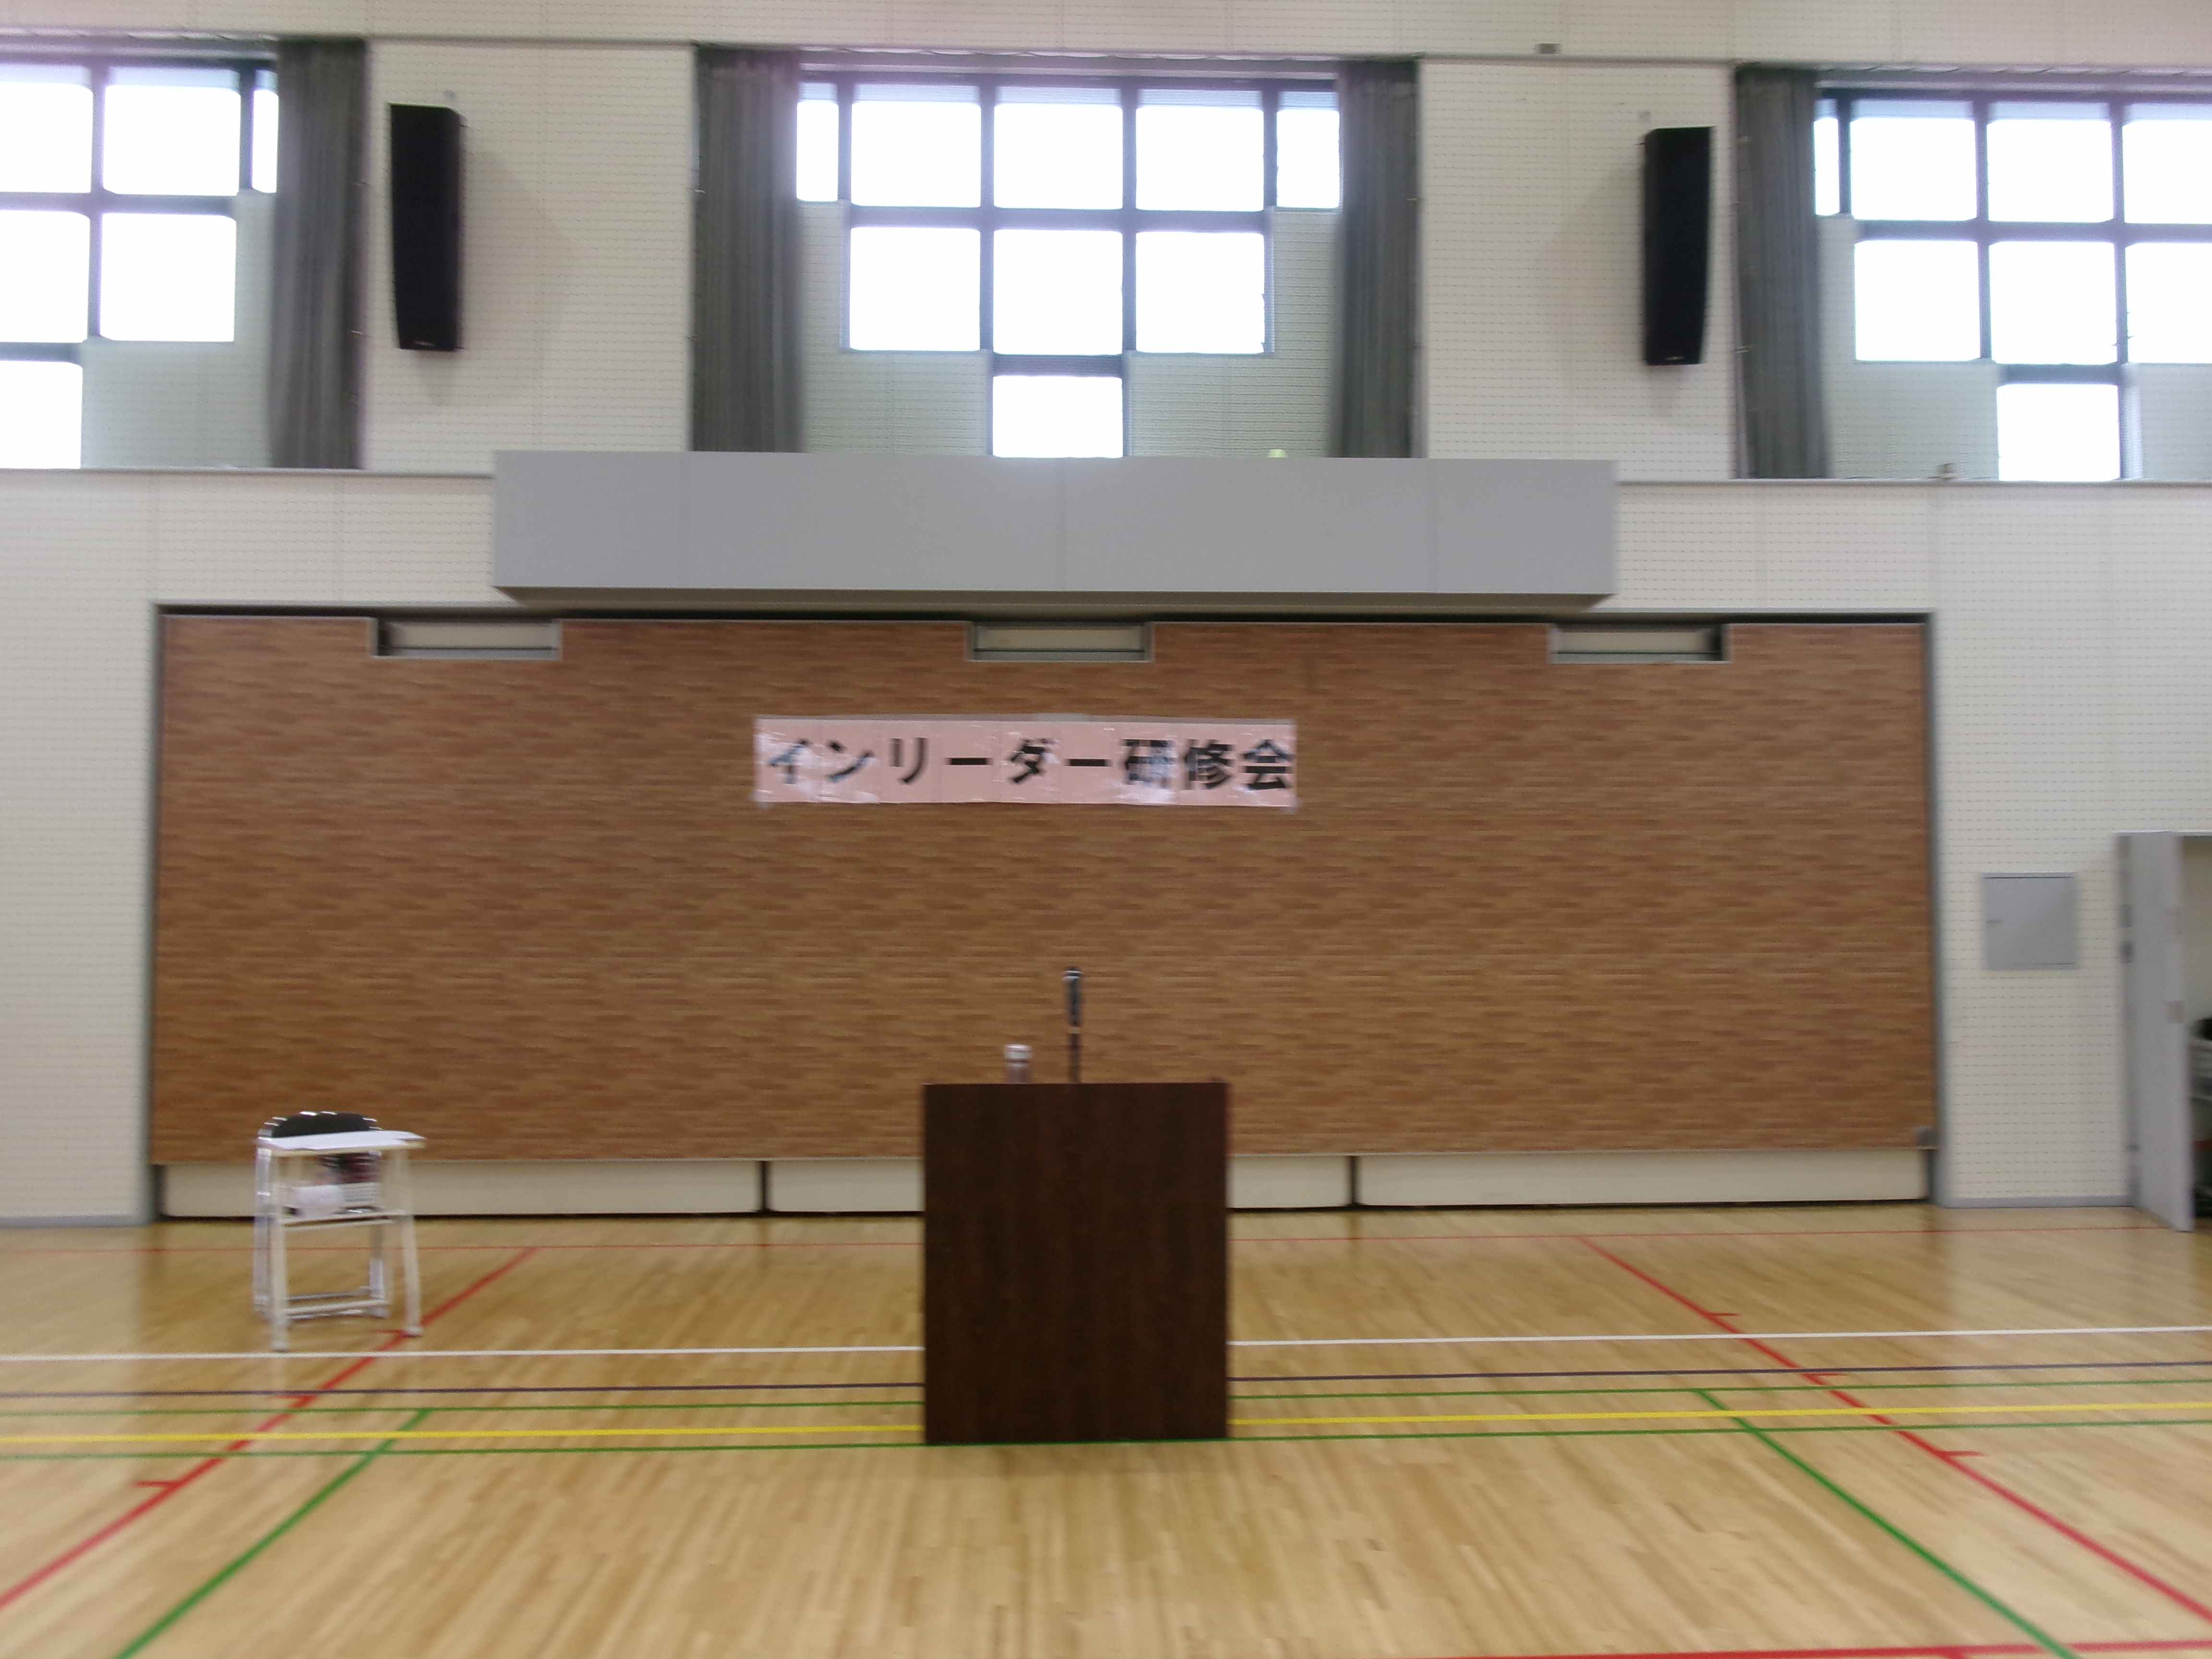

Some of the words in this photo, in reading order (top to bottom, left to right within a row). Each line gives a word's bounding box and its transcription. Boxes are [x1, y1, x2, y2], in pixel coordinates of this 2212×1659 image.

[769, 737, 1293, 790] インリーダー研修会
